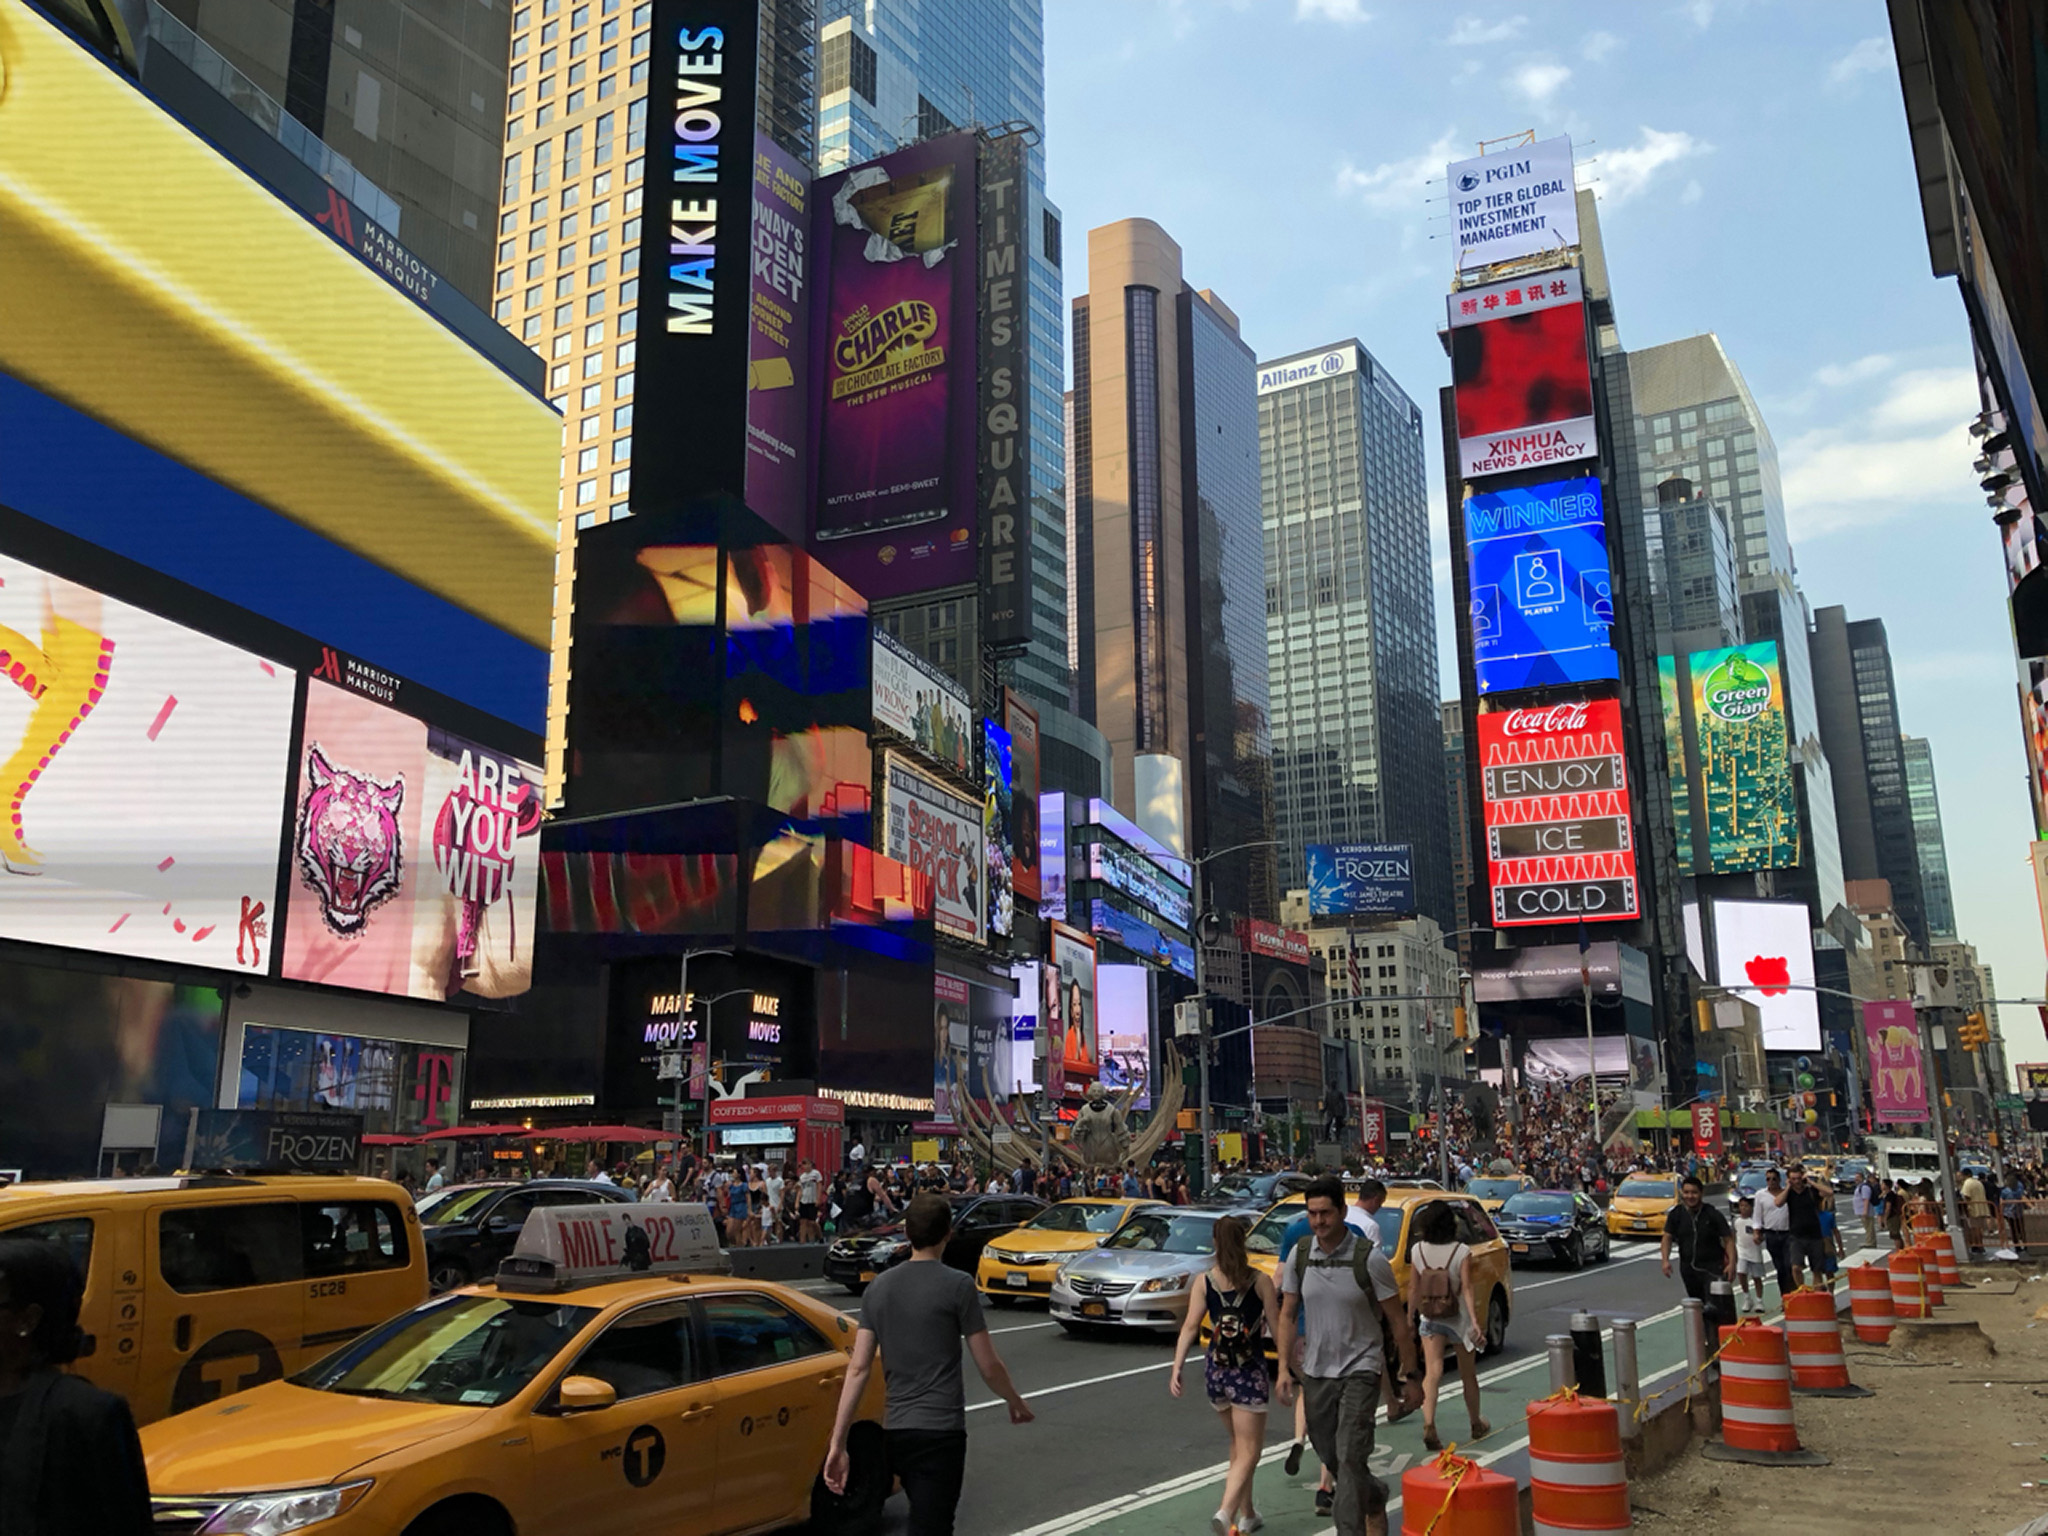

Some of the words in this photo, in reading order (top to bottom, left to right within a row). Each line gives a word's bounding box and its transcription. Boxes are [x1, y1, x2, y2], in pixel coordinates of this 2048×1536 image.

[673, 26, 724, 182] MOVES
[775, 167, 804, 197] AND
[1485, 160, 1531, 183] PGIM
[1457, 199, 1482, 215] TOP
[1485, 191, 1513, 208] TIER
[1517, 179, 1566, 200] GLOBAL
[1459, 202, 1536, 231] INVESTMENT
[1460, 216, 1546, 246] MANAGEMENT
[365, 222, 438, 288] MARRIOTT
[667, 198, 717, 335] MAKE
[986, 178, 1015, 347] TIMES
[363, 241, 428, 300] MARQUIS
[1461, 280, 1568, 315] 新华通讯社
[836, 302, 932, 368] CHARLIE
[847, 361, 901, 391] CHOCOLATE
[903, 350, 941, 373] FACTORY
[1260, 363, 1318, 389] Allianz
[847, 394, 864, 407] THE
[867, 387, 887, 402] NEW
[890, 373, 932, 392] MUSICAL
[1472, 455, 1516, 473] NEWS
[1520, 443, 1586, 465] AGENCY
[1488, 430, 1567, 457] XINHUA
[987, 368, 1017, 585] SQUARE
[855, 488, 877, 500] DARK
[1470, 492, 1599, 534] WINNER
[1524, 606, 1553, 616] PLAYER
[346, 674, 394, 702] MARQUIS
[347, 660, 401, 690] MARRIOTT
[891, 674, 912, 699] GOES
[874, 680, 912, 722] WRONG
[1712, 685, 1768, 703] Green
[1720, 700, 1772, 718] Giant
[1502, 702, 1591, 736] Coca-Cola
[453, 748, 521, 812] ARE
[1502, 762, 1604, 794] ENJOY
[451, 796, 519, 860] YOU
[908, 799, 961, 855] SCHOOL
[1535, 825, 1584, 852] ICE
[439, 844, 514, 905] WITH
[909, 838, 961, 904] ROCK
[1335, 857, 1410, 882] FROZEN
[1518, 886, 1606, 914] COLD
[1508, 968, 1533, 978] drivers
[753, 994, 779, 1016] MAKE
[644, 1020, 698, 1043] MOVES
[749, 1021, 781, 1043] MOVES
[415, 1053, 454, 1126] T
[713, 1105, 754, 1117] COFFEED
[1698, 1107, 1715, 1138] tkts
[1366, 1112, 1381, 1141] tkts
[266, 1127, 357, 1168] FROZEN
[675, 1213, 710, 1226] AUGUST
[691, 1228, 701, 1241] 17
[558, 1219, 619, 1269] MILE
[646, 1216, 679, 1262] 22
